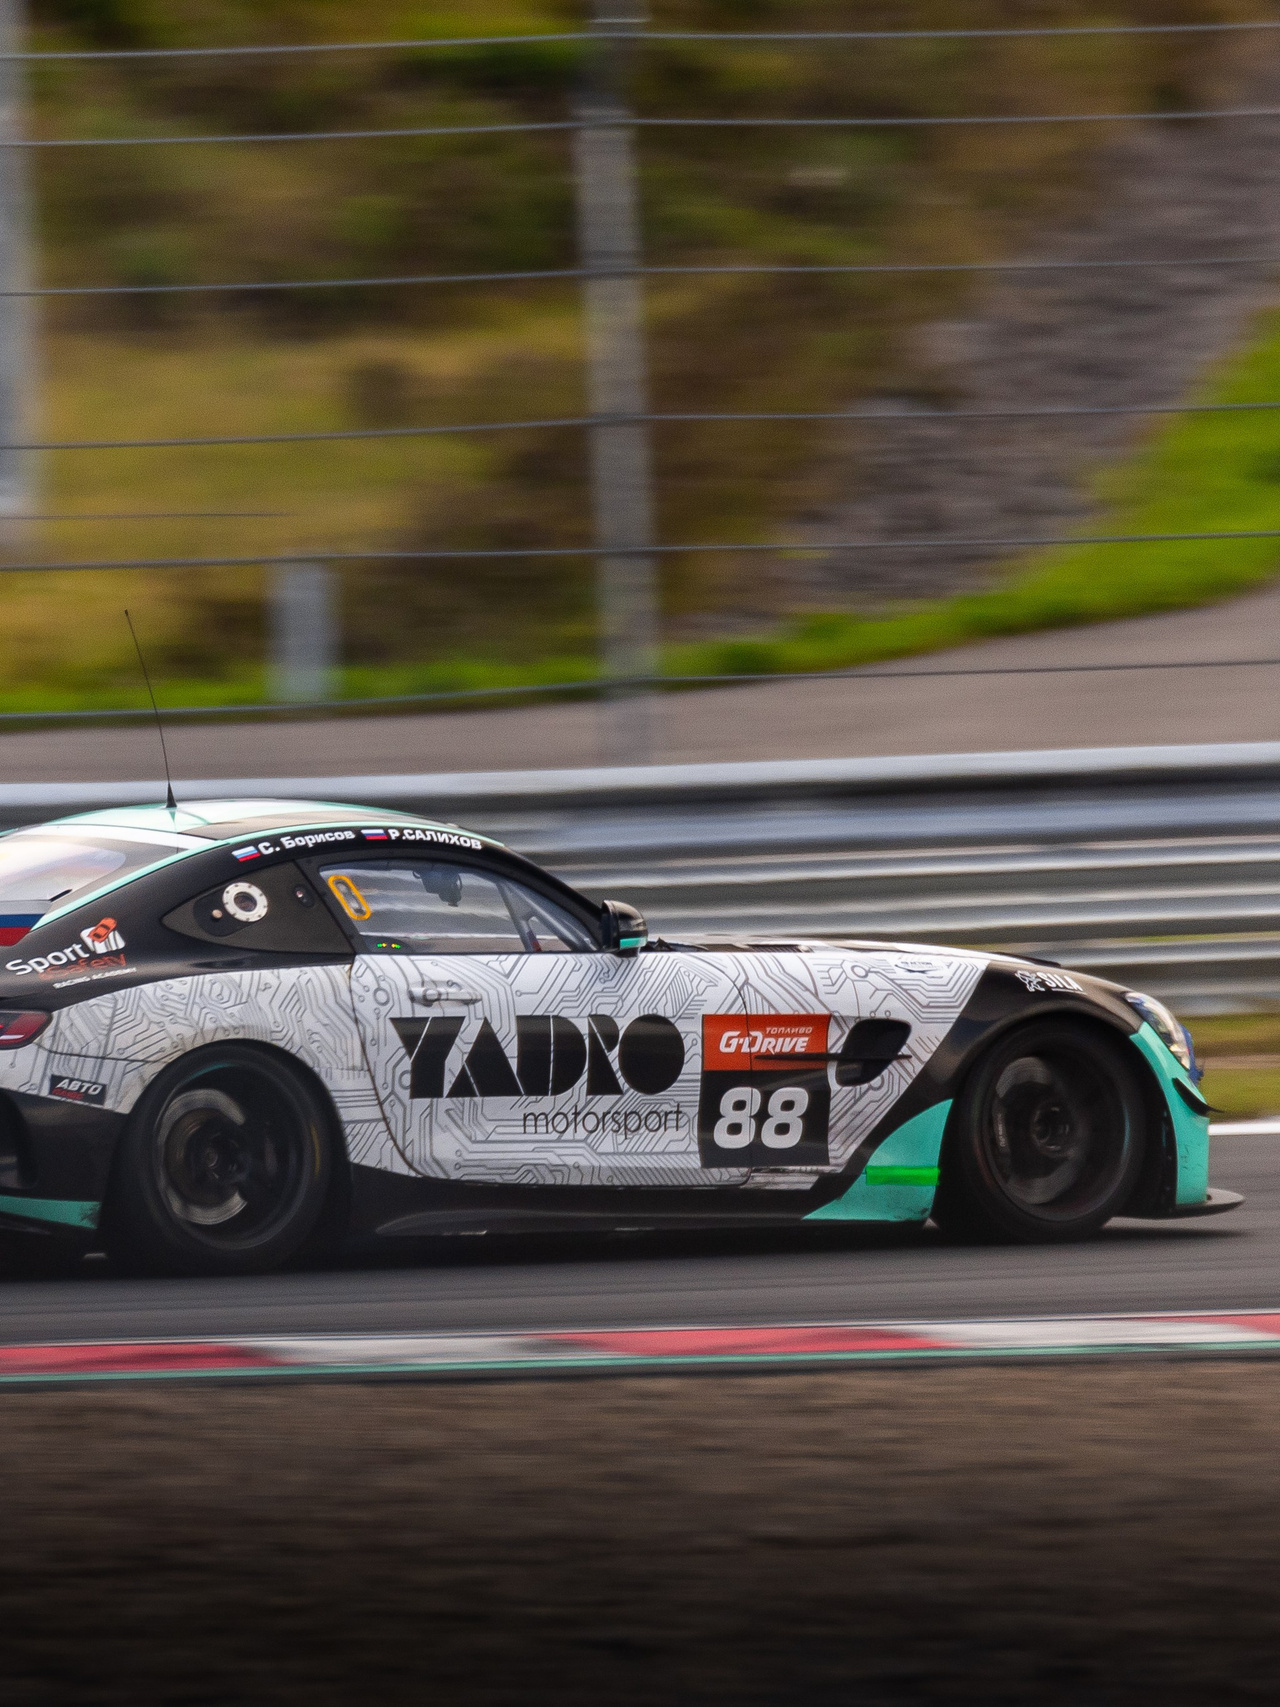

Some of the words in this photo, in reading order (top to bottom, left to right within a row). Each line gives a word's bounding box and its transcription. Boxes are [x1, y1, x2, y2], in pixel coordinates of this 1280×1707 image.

[280, 829, 356, 849] Борисов
[5, 943, 90, 976] Sport
[1036, 971, 1083, 991] SILA
[389, 1014, 685, 1099] YADRO
[523, 1104, 682, 1139] motorsport
[714, 1086, 810, 1149] 88
